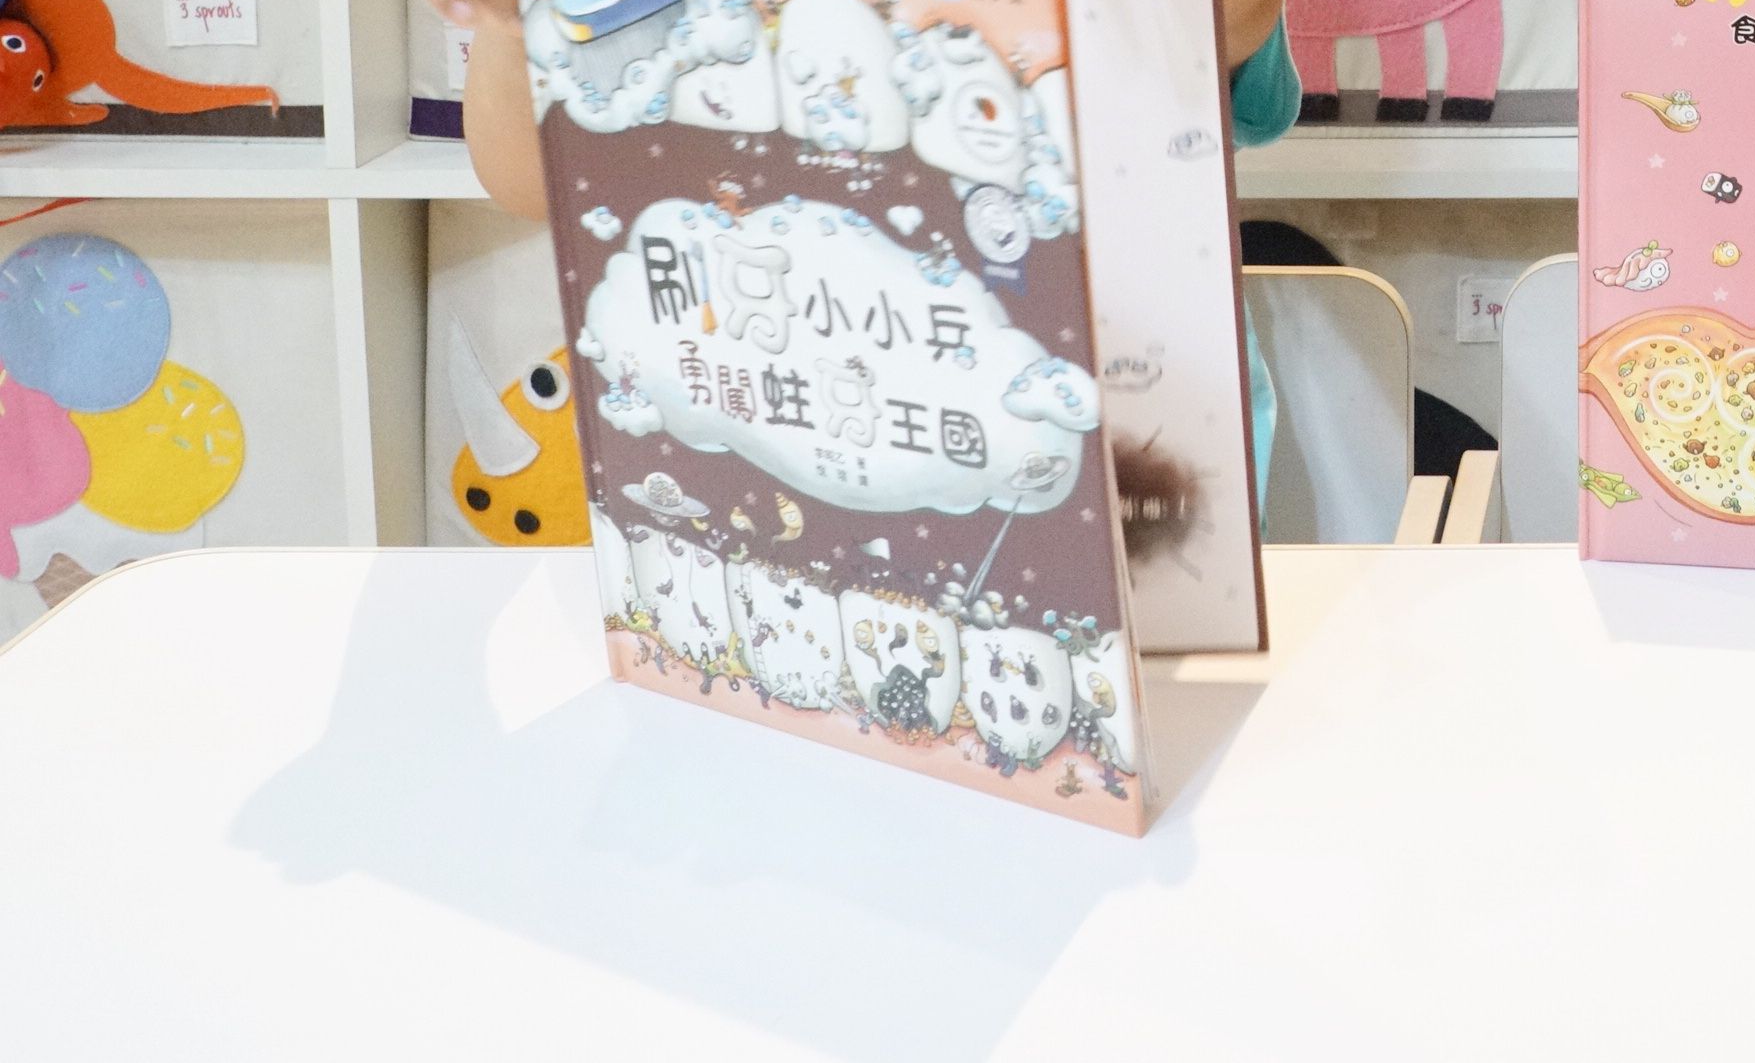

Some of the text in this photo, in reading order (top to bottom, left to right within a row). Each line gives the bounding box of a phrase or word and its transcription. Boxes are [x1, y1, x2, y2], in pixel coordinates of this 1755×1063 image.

[641, 233, 973, 362] 刷牙小小兵
[677, 338, 988, 470] 勇闖蛀牙王國
